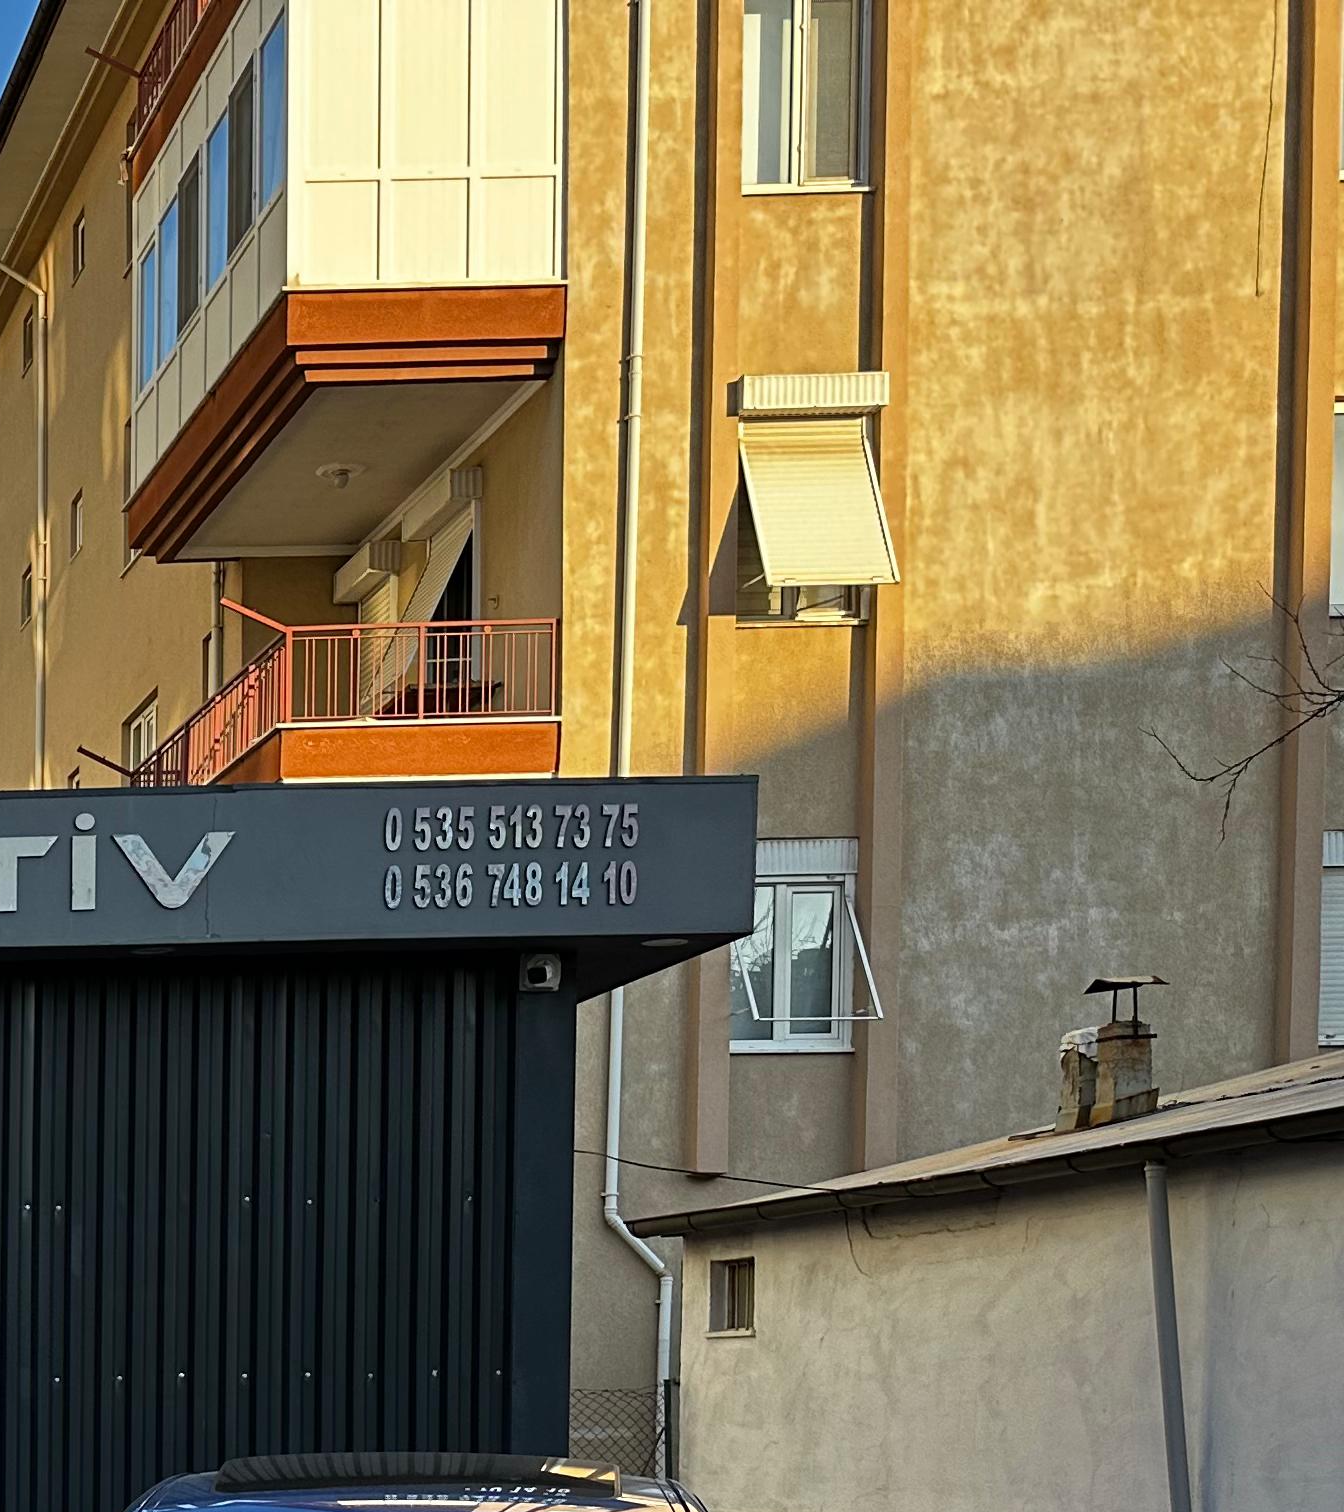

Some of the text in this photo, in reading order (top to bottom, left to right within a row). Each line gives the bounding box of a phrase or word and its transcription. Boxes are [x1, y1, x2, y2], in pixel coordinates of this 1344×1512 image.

[384, 803, 639, 851] 0 535 513 73 75
[384, 860, 638, 909] 0 536 748 14 10
